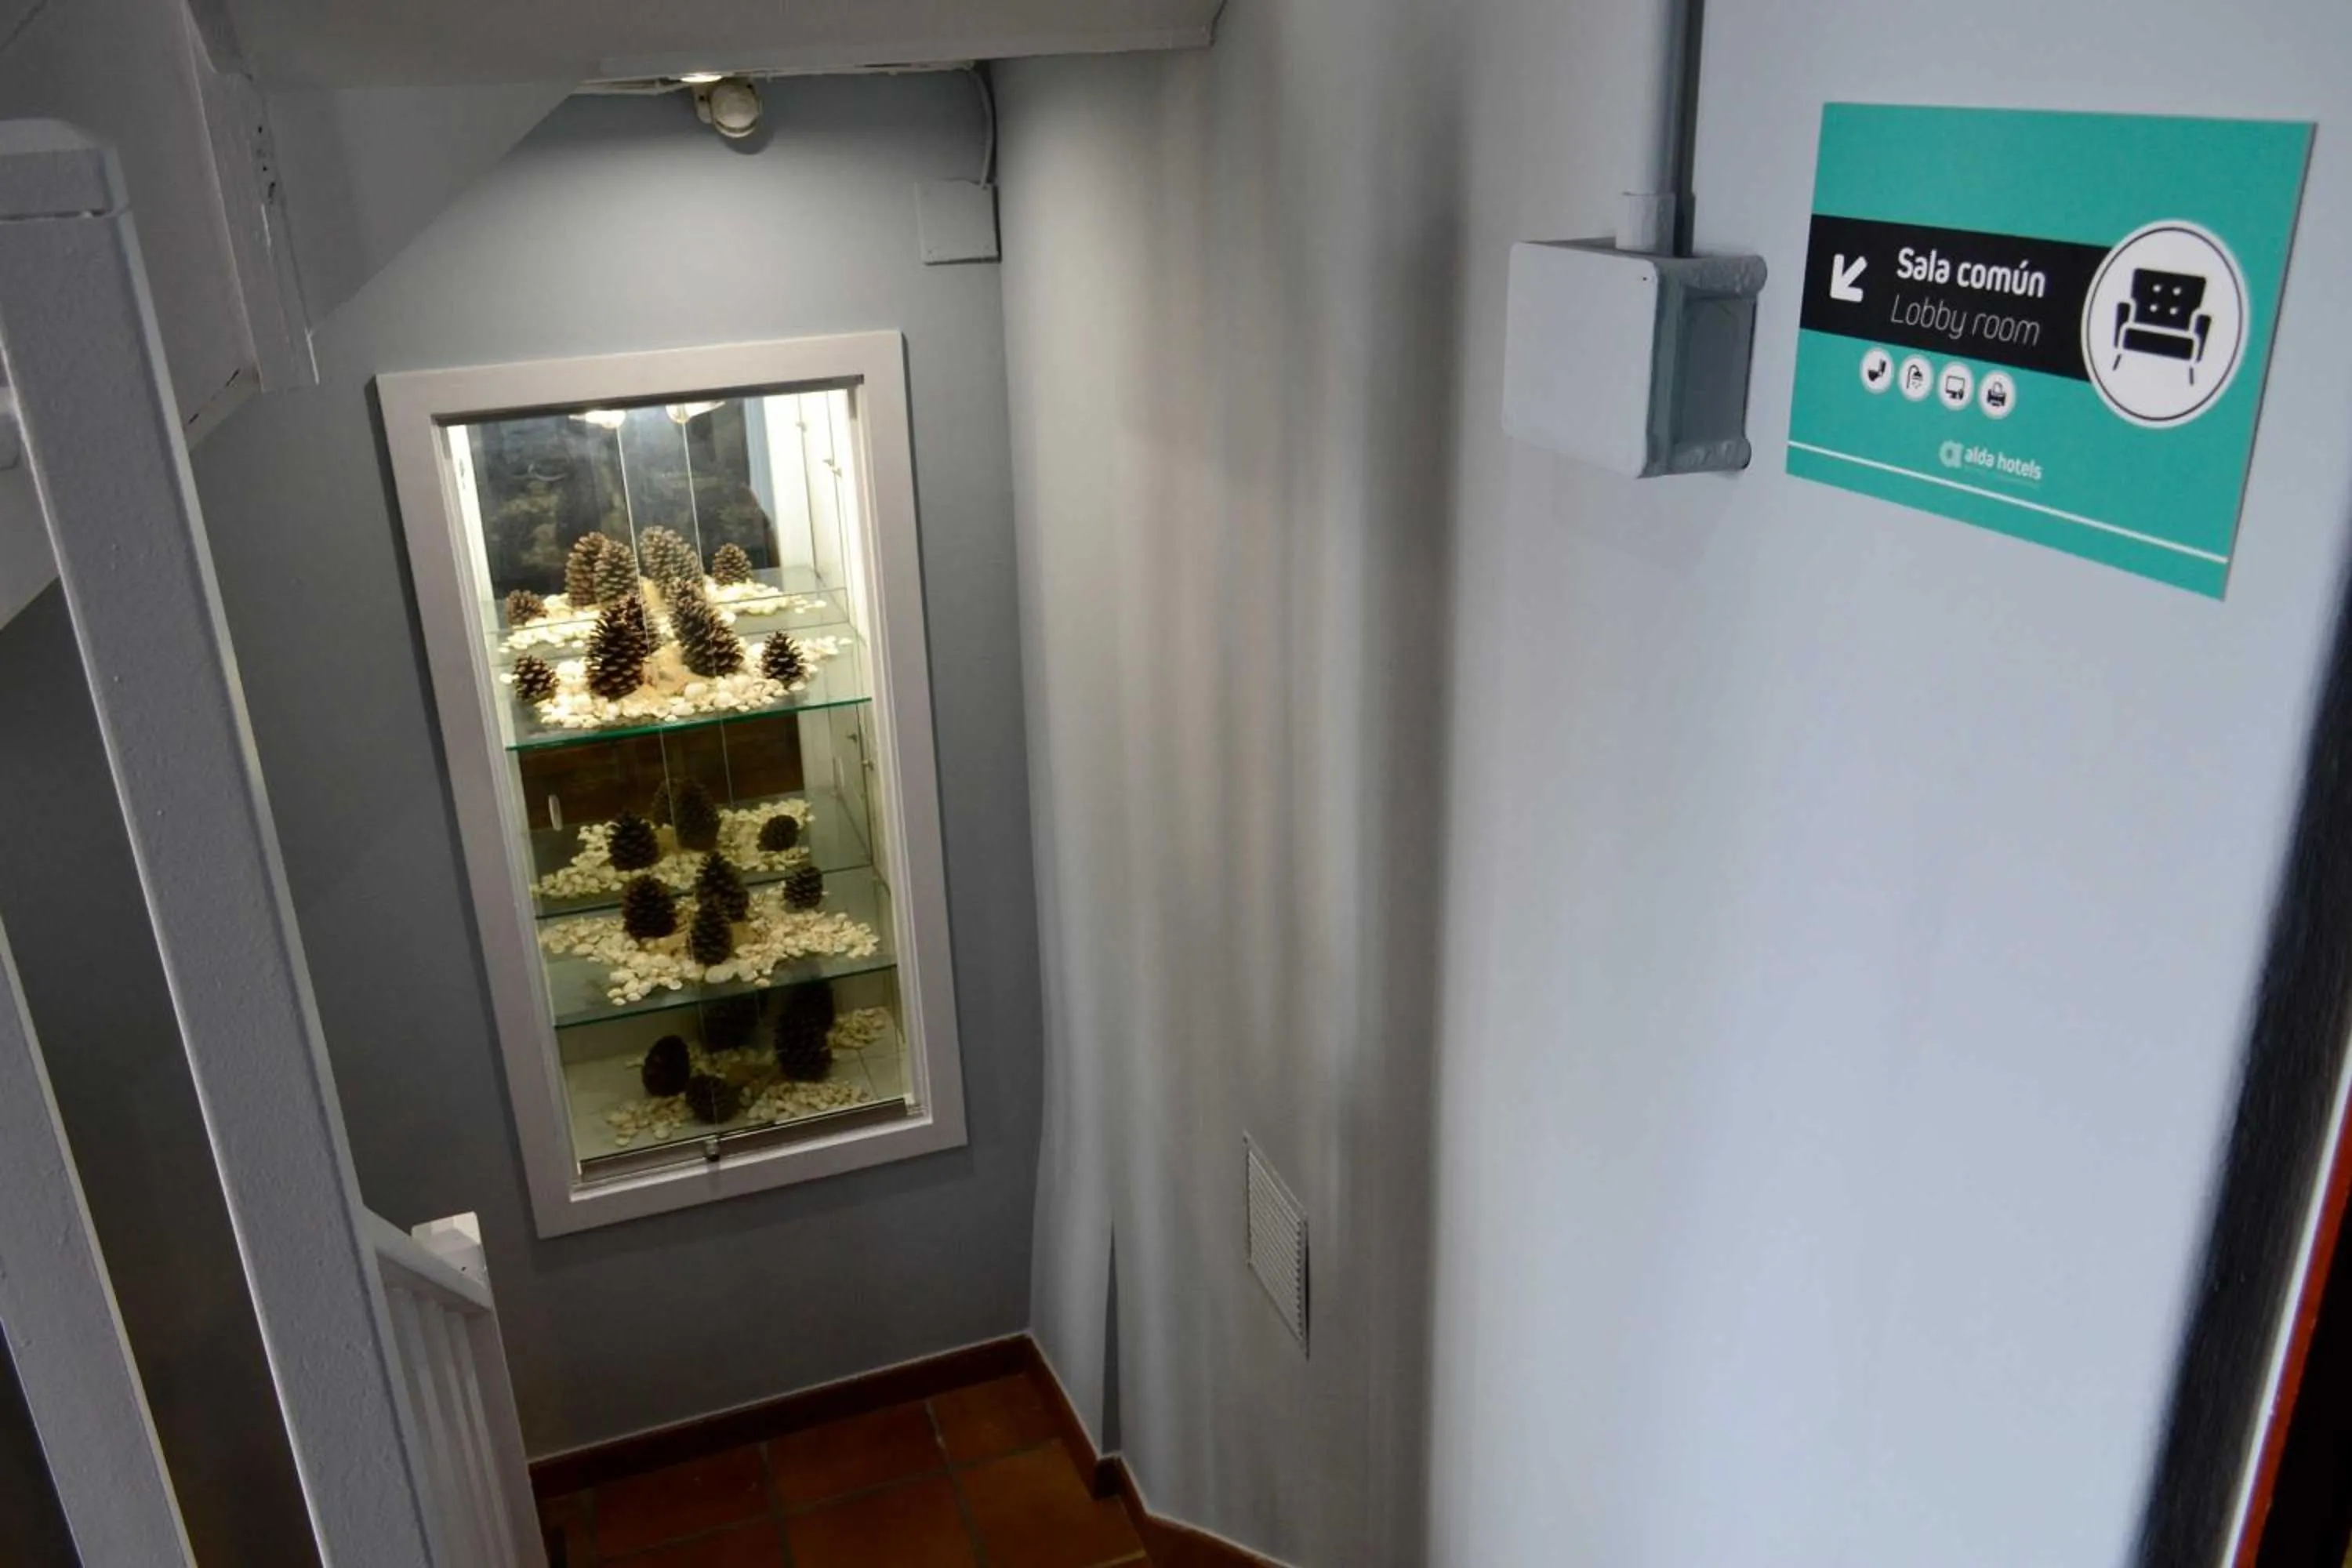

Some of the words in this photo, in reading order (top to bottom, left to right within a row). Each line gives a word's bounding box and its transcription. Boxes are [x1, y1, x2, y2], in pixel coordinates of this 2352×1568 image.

[1896, 247, 1951, 285] Sala
[1957, 259, 2045, 298] común
[1890, 294, 1968, 339] Lobby
[1971, 313, 2042, 347] room
[1964, 446, 1995, 467] alda
[1996, 452, 2043, 480] hotels
